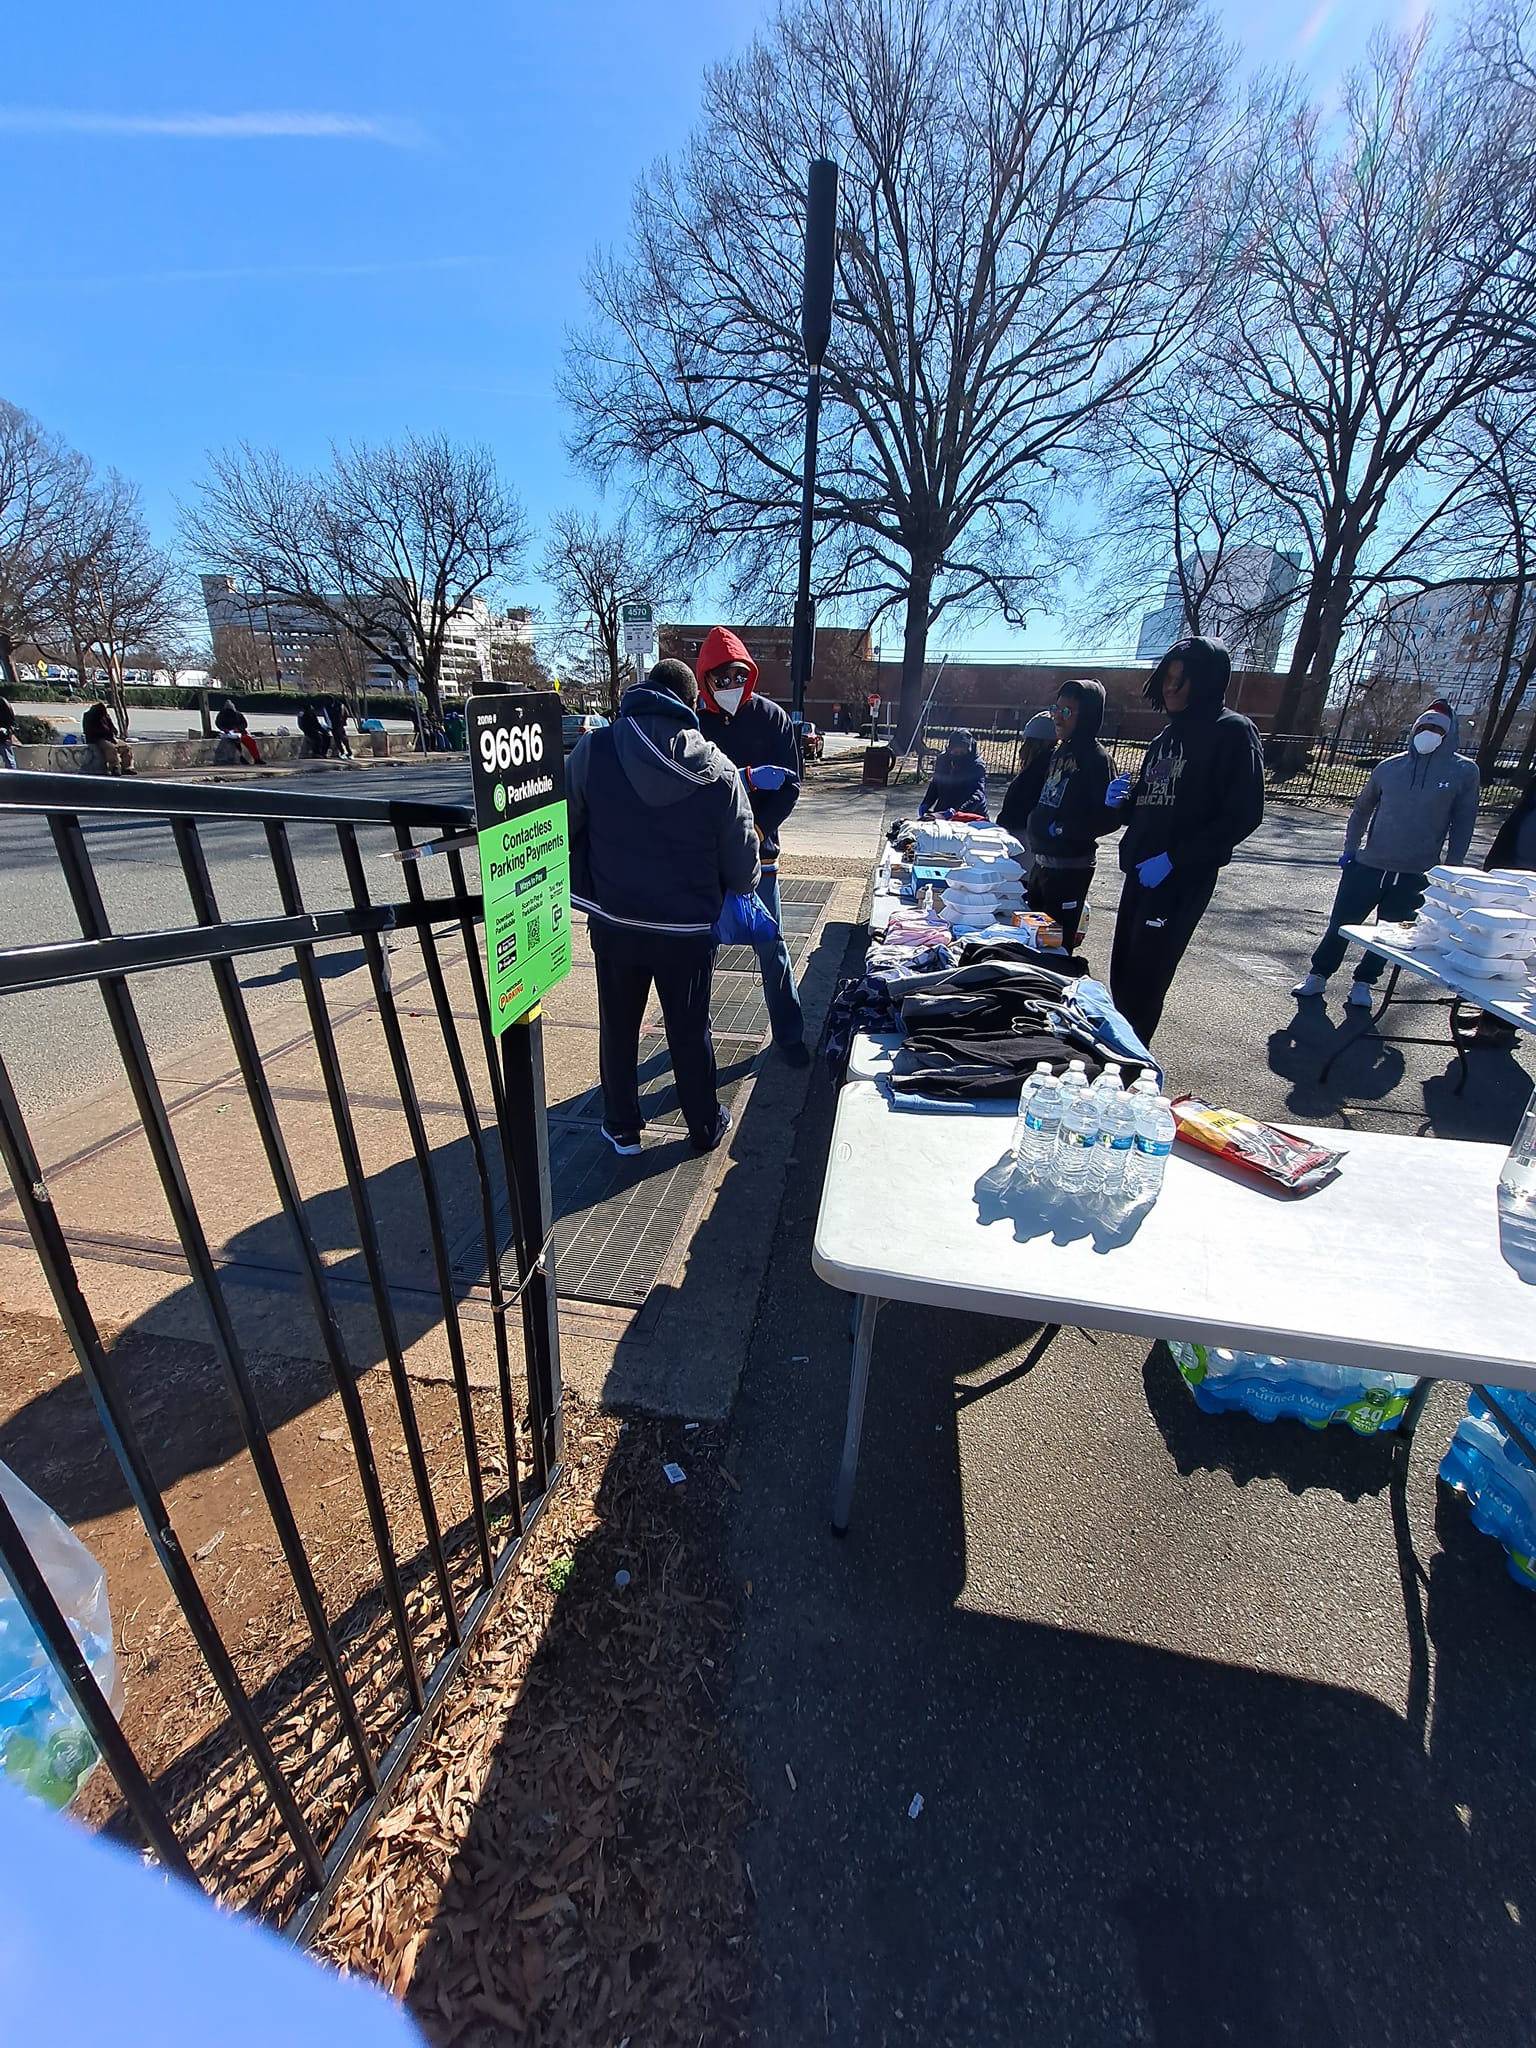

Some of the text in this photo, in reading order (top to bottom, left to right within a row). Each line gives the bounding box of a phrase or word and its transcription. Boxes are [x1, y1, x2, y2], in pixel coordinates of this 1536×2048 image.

[627, 608, 647, 616] 4570
[477, 714, 493, 725] zone
[480, 723, 544, 774] 96616
[507, 774, 554, 804] ParkMobile
[502, 820, 552, 851] Contactless
[490, 833, 564, 881] Parking Payments
[1246, 1387, 1295, 1403] Purified
[1355, 1406, 1384, 1422] 40
